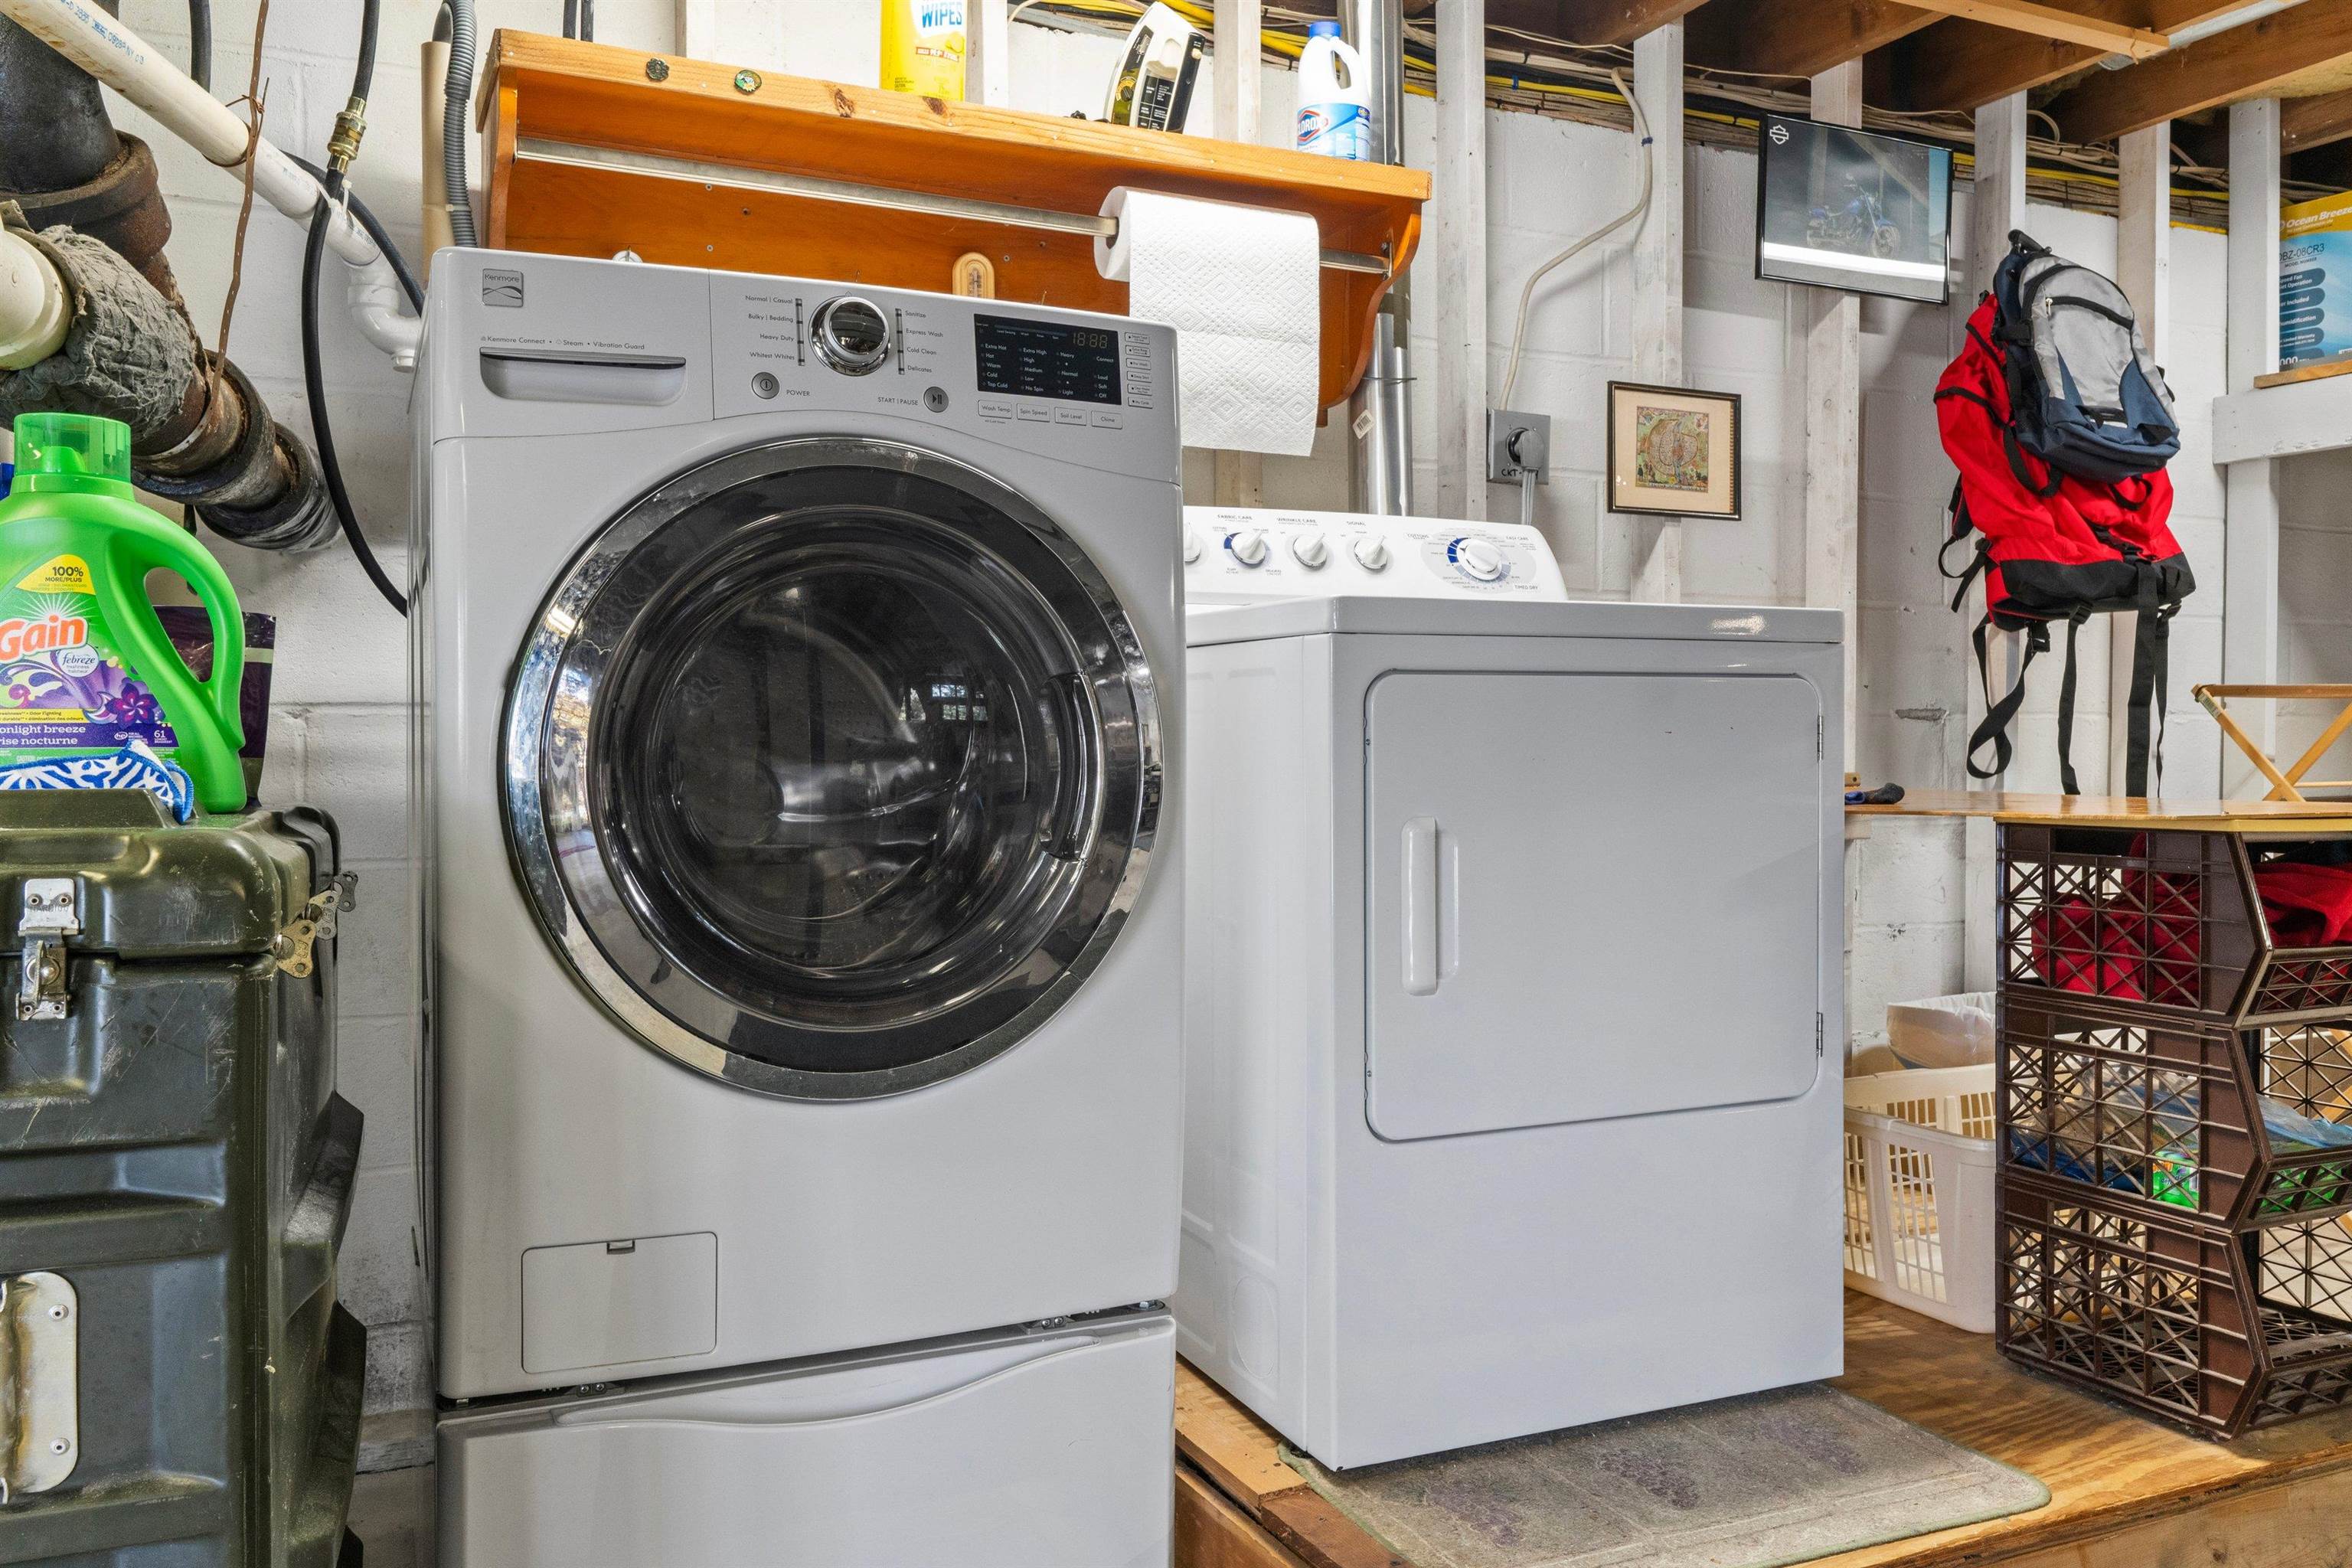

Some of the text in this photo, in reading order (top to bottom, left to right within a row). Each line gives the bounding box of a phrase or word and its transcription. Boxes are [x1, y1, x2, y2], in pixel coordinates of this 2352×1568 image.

[922, 5, 962, 28] WIPES
[2286, 215, 2319, 228] Ocean
[485, 273, 520, 283] Kenmore
[2288, 279, 2313, 288] Operation
[2287, 296, 2310, 305] Included
[748, 313, 764, 322] Bulky
[905, 310, 926, 318] Sanitize
[906, 328, 926, 337] Express
[907, 365, 933, 374] Delicates
[52, 567, 83, 577] 100%
[0, 615, 85, 661] Gain
[62, 653, 96, 665] febreze
[0, 725, 86, 735] onlight breeze
[154, 730, 166, 738] 61
